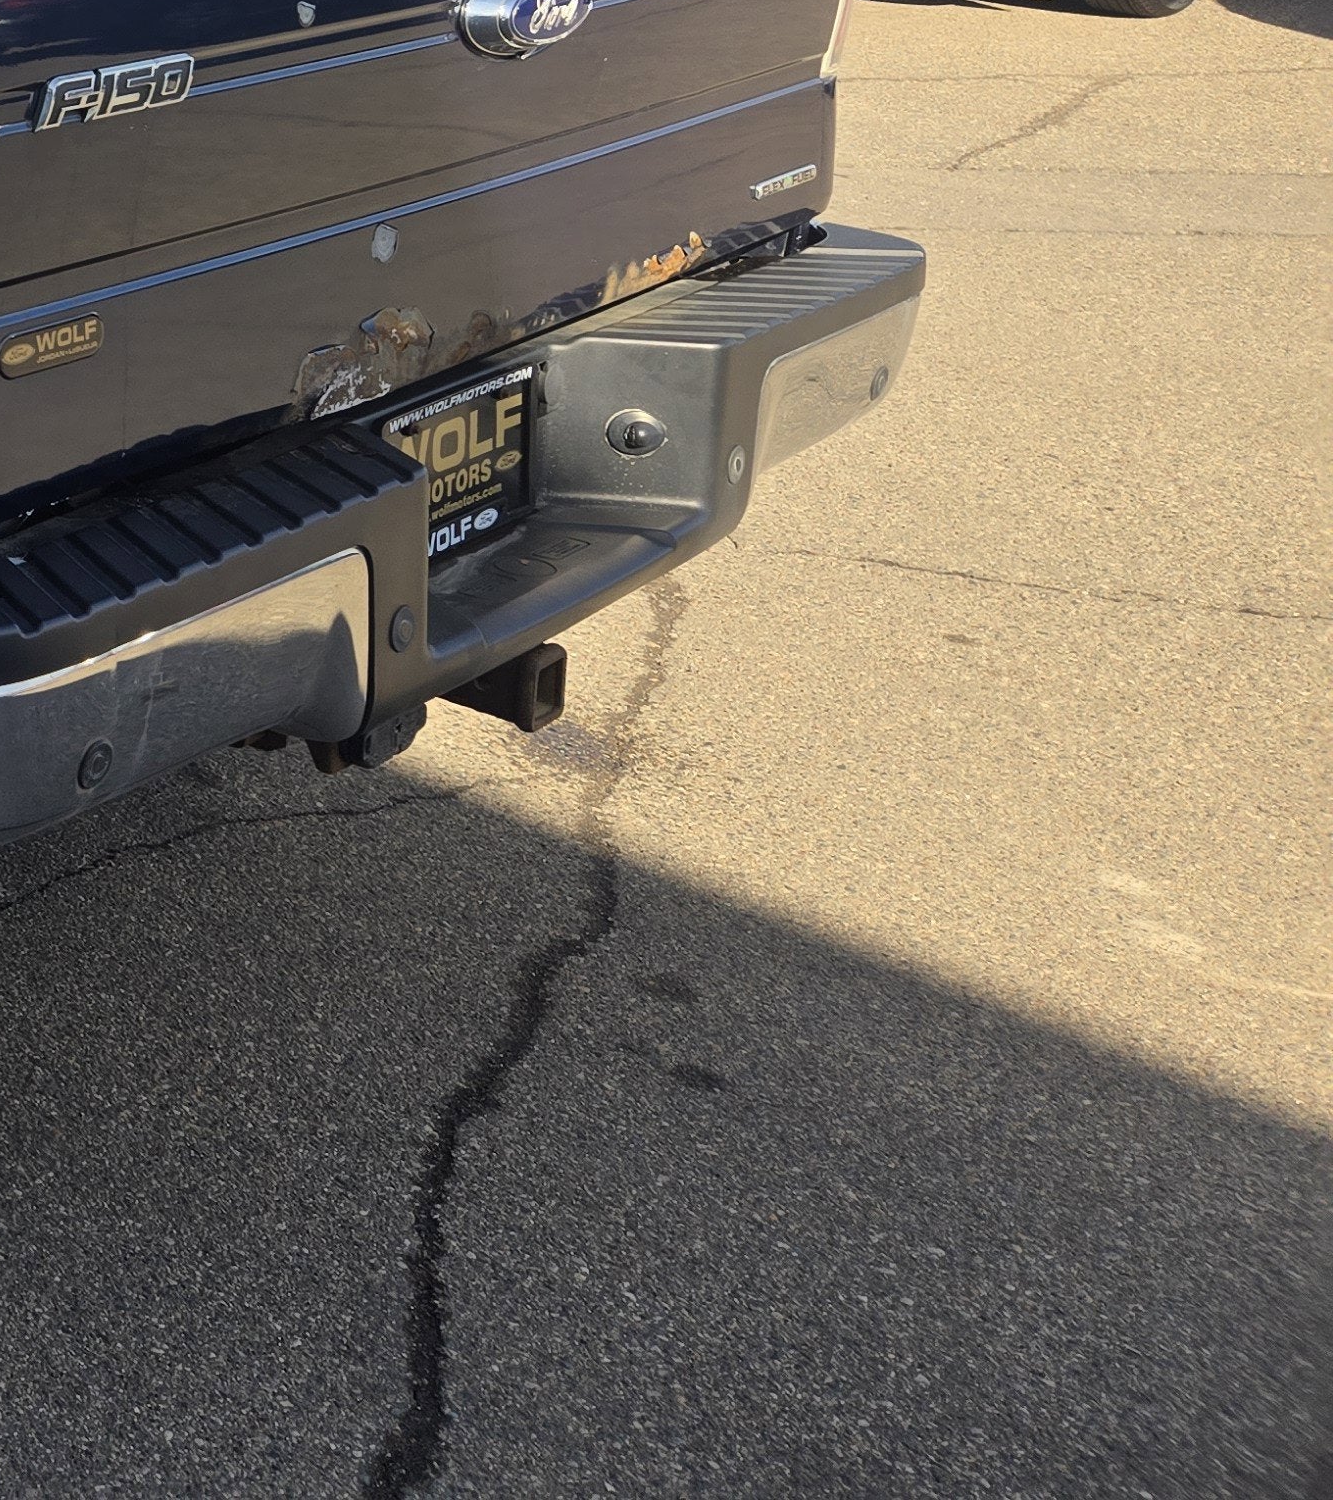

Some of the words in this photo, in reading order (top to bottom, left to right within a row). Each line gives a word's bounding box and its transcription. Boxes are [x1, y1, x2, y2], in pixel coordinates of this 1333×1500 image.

[35, 52, 195, 132] F-150
[35, 320, 97, 353] WOLF
[389, 366, 533, 434] WWW.WOLFMOTORS.COM
[429, 458, 492, 504] OTORS
